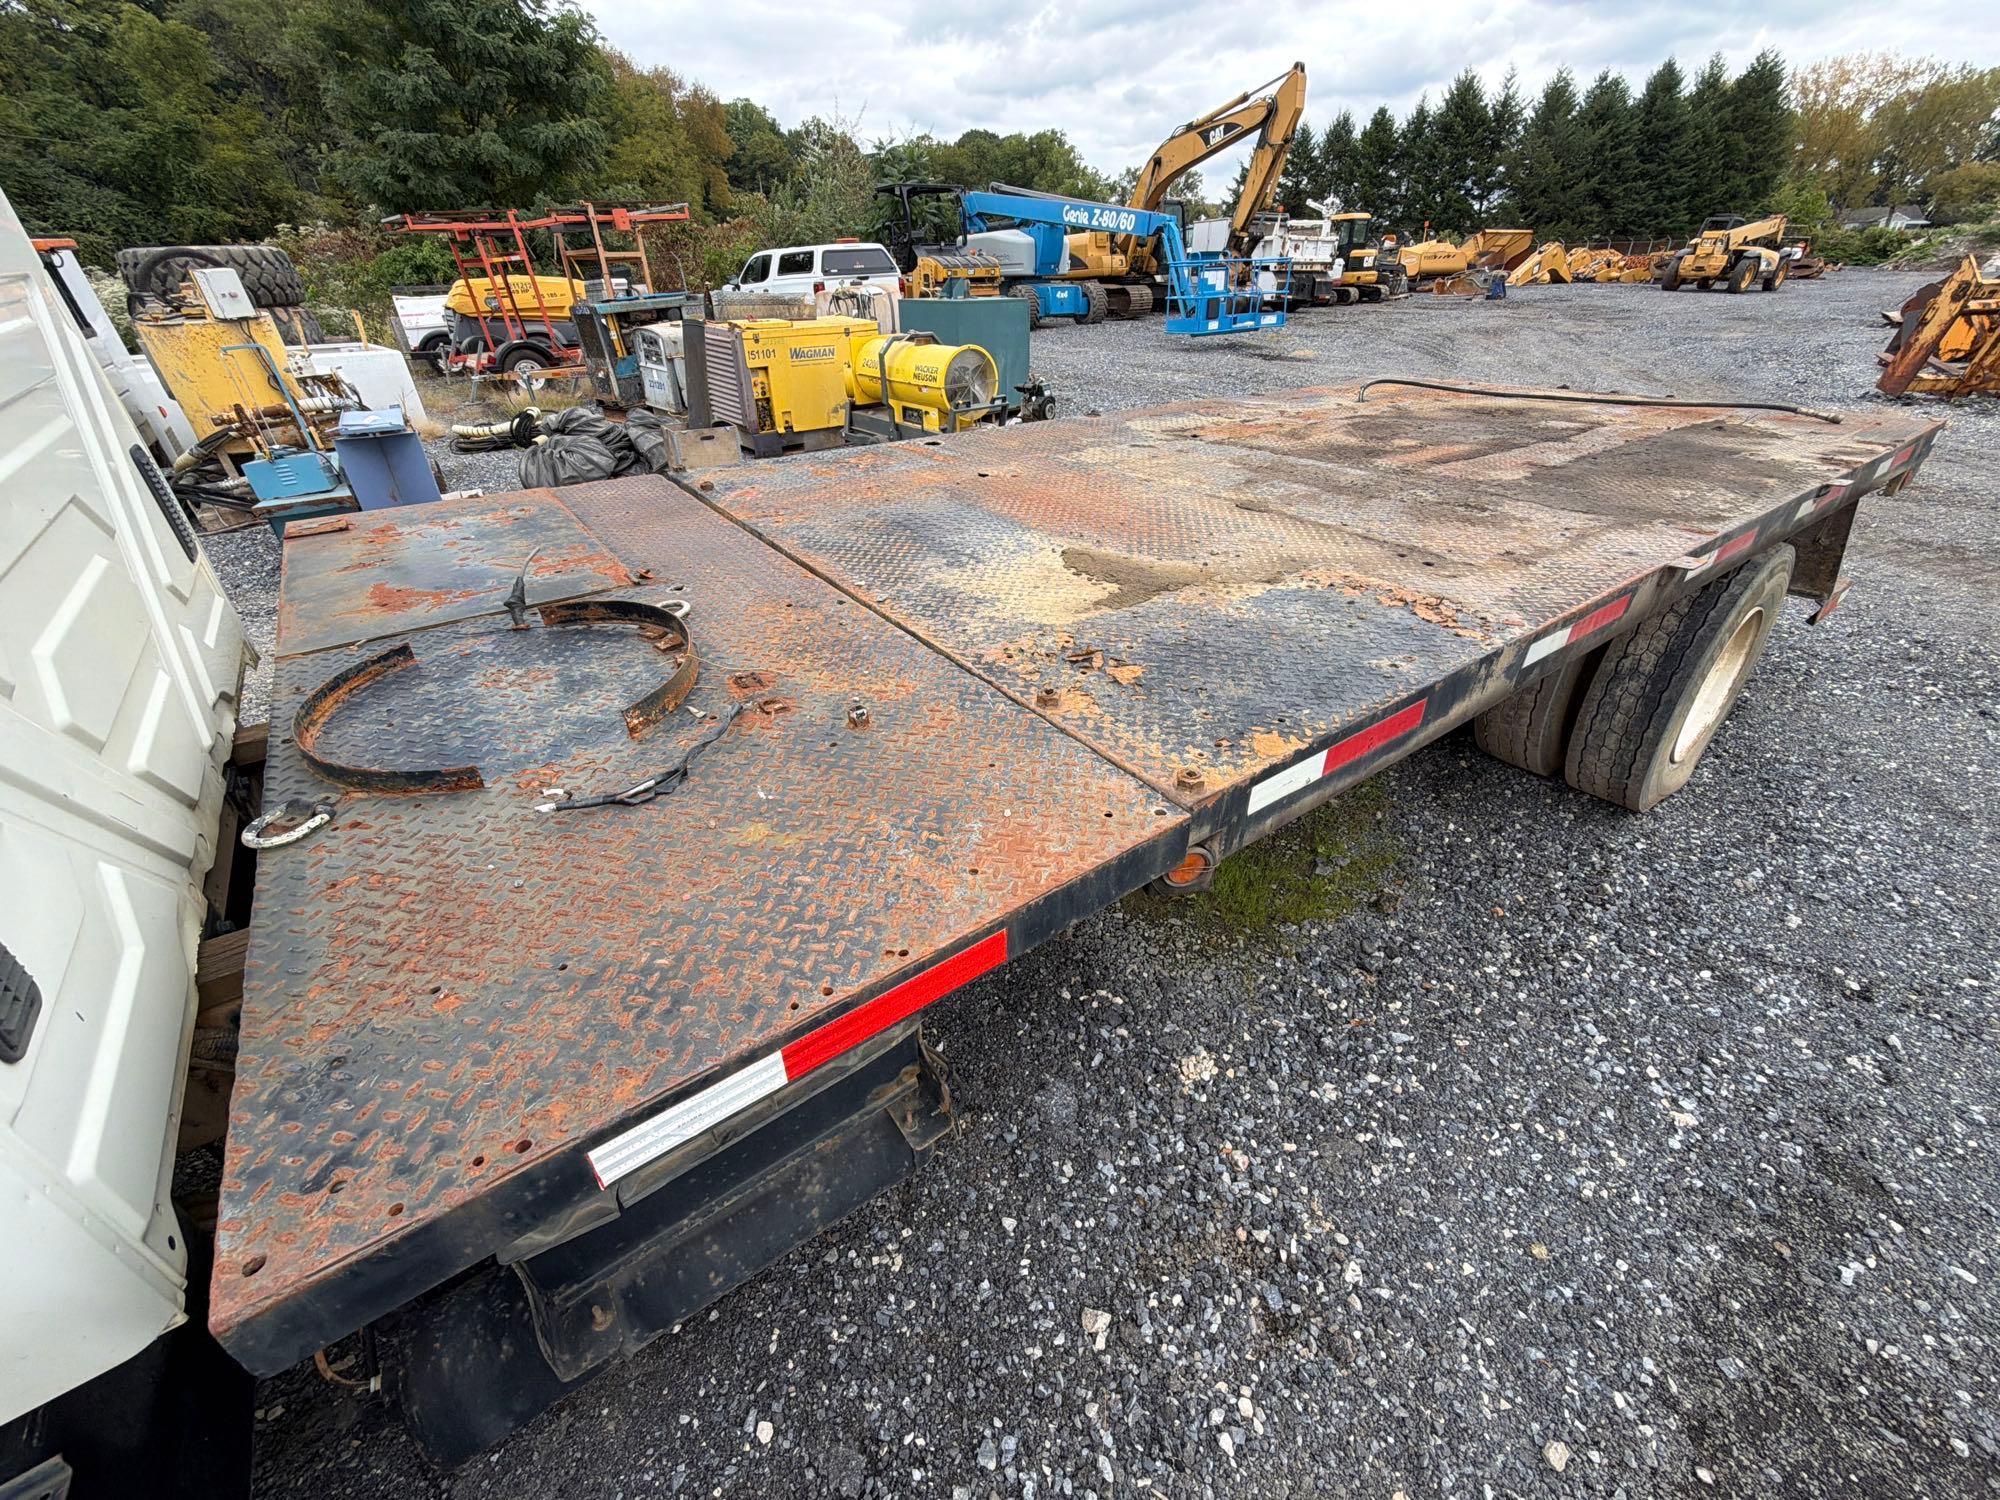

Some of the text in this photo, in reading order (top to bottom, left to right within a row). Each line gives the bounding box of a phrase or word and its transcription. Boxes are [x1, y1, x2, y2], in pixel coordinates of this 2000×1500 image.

[1208, 124, 1225, 146] CAT
[1063, 204, 1136, 231] Genie Z-80/60
[1056, 290, 1068, 299] 4x4
[747, 349, 776, 361] 151101
[789, 347, 835, 360] WAGMAN
[915, 363, 939, 375] WACKER
[913, 371, 938, 383] NEUSON
